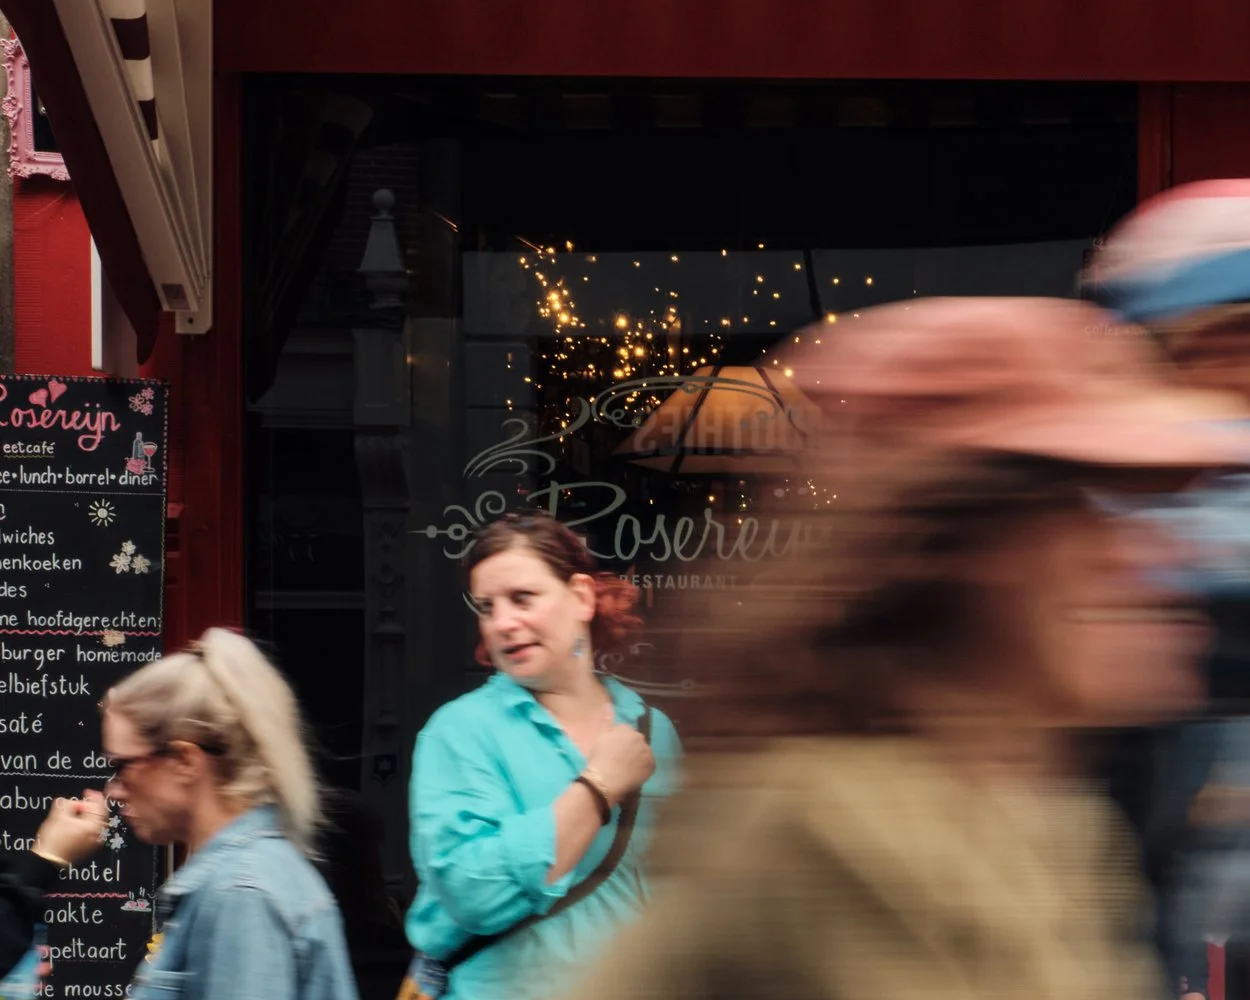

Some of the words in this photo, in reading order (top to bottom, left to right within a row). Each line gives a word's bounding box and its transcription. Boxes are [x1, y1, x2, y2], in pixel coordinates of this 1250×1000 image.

[3, 441, 55, 454] eetcafé
[20, 463, 57, 484] lunch
[65, 466, 110, 485] borrel
[118, 468, 159, 486] diner
[0, 525, 55, 545] wiches
[0, 553, 82, 571] enkoeken
[1, 641, 66, 671] burger
[77, 643, 162, 662] homemade
[0, 672, 91, 699] elbiefstuk
[0, 711, 43, 734] saté
[0, 755, 37, 770] van
[47, 750, 72, 770] de
[44, 901, 104, 924] aakte
